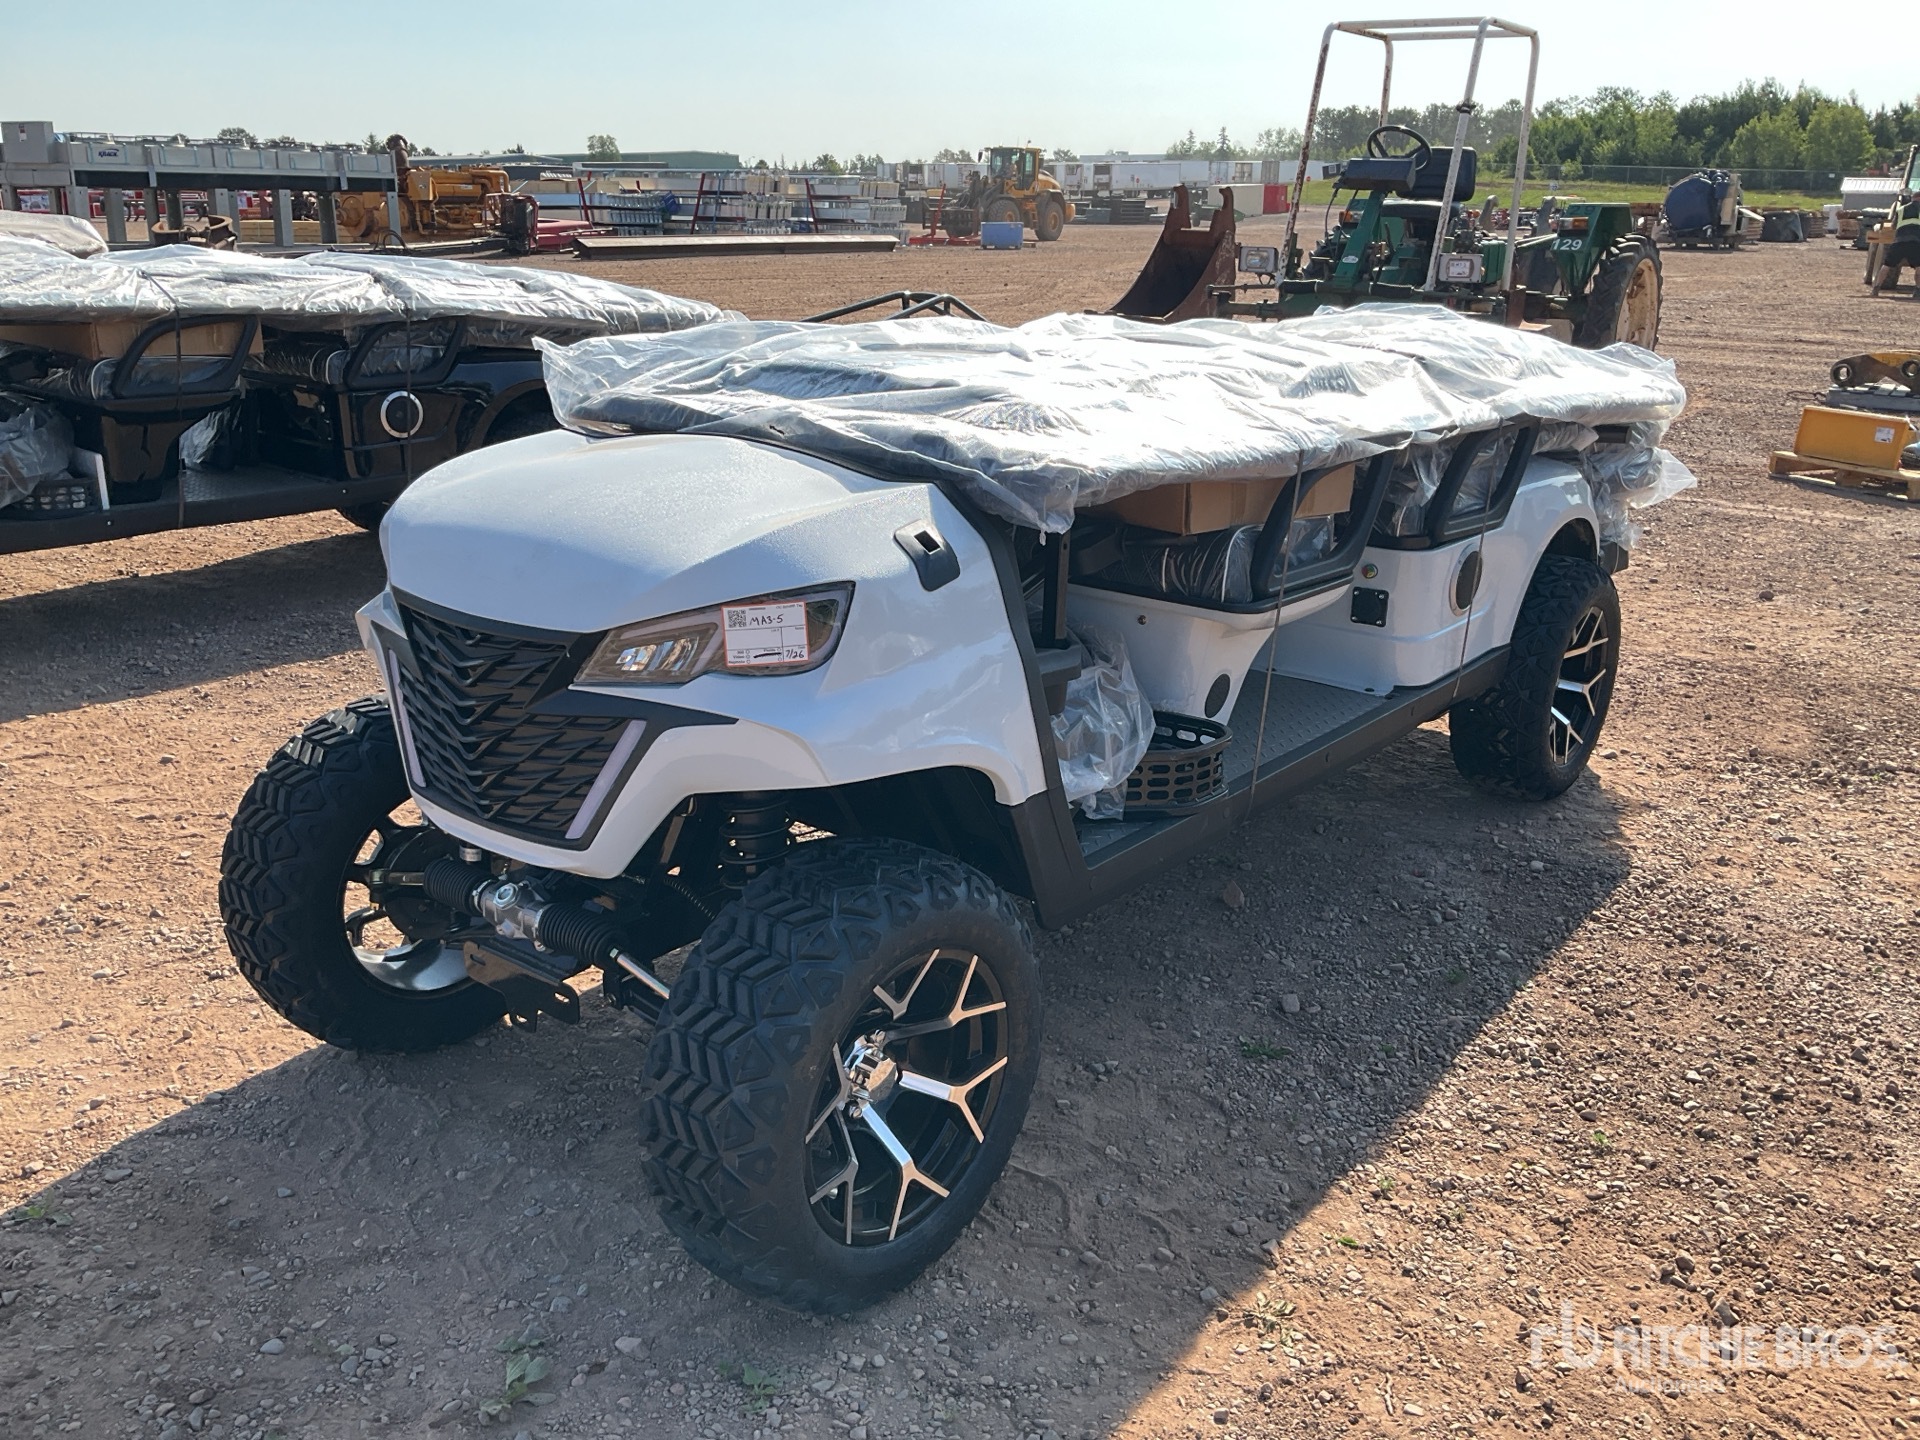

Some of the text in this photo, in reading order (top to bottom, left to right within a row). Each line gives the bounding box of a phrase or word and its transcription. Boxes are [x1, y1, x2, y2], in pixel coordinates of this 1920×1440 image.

[1552, 238, 1583, 251] 129
[749, 613, 784, 626] MA3-5
[785, 648, 805, 659] 7/26
